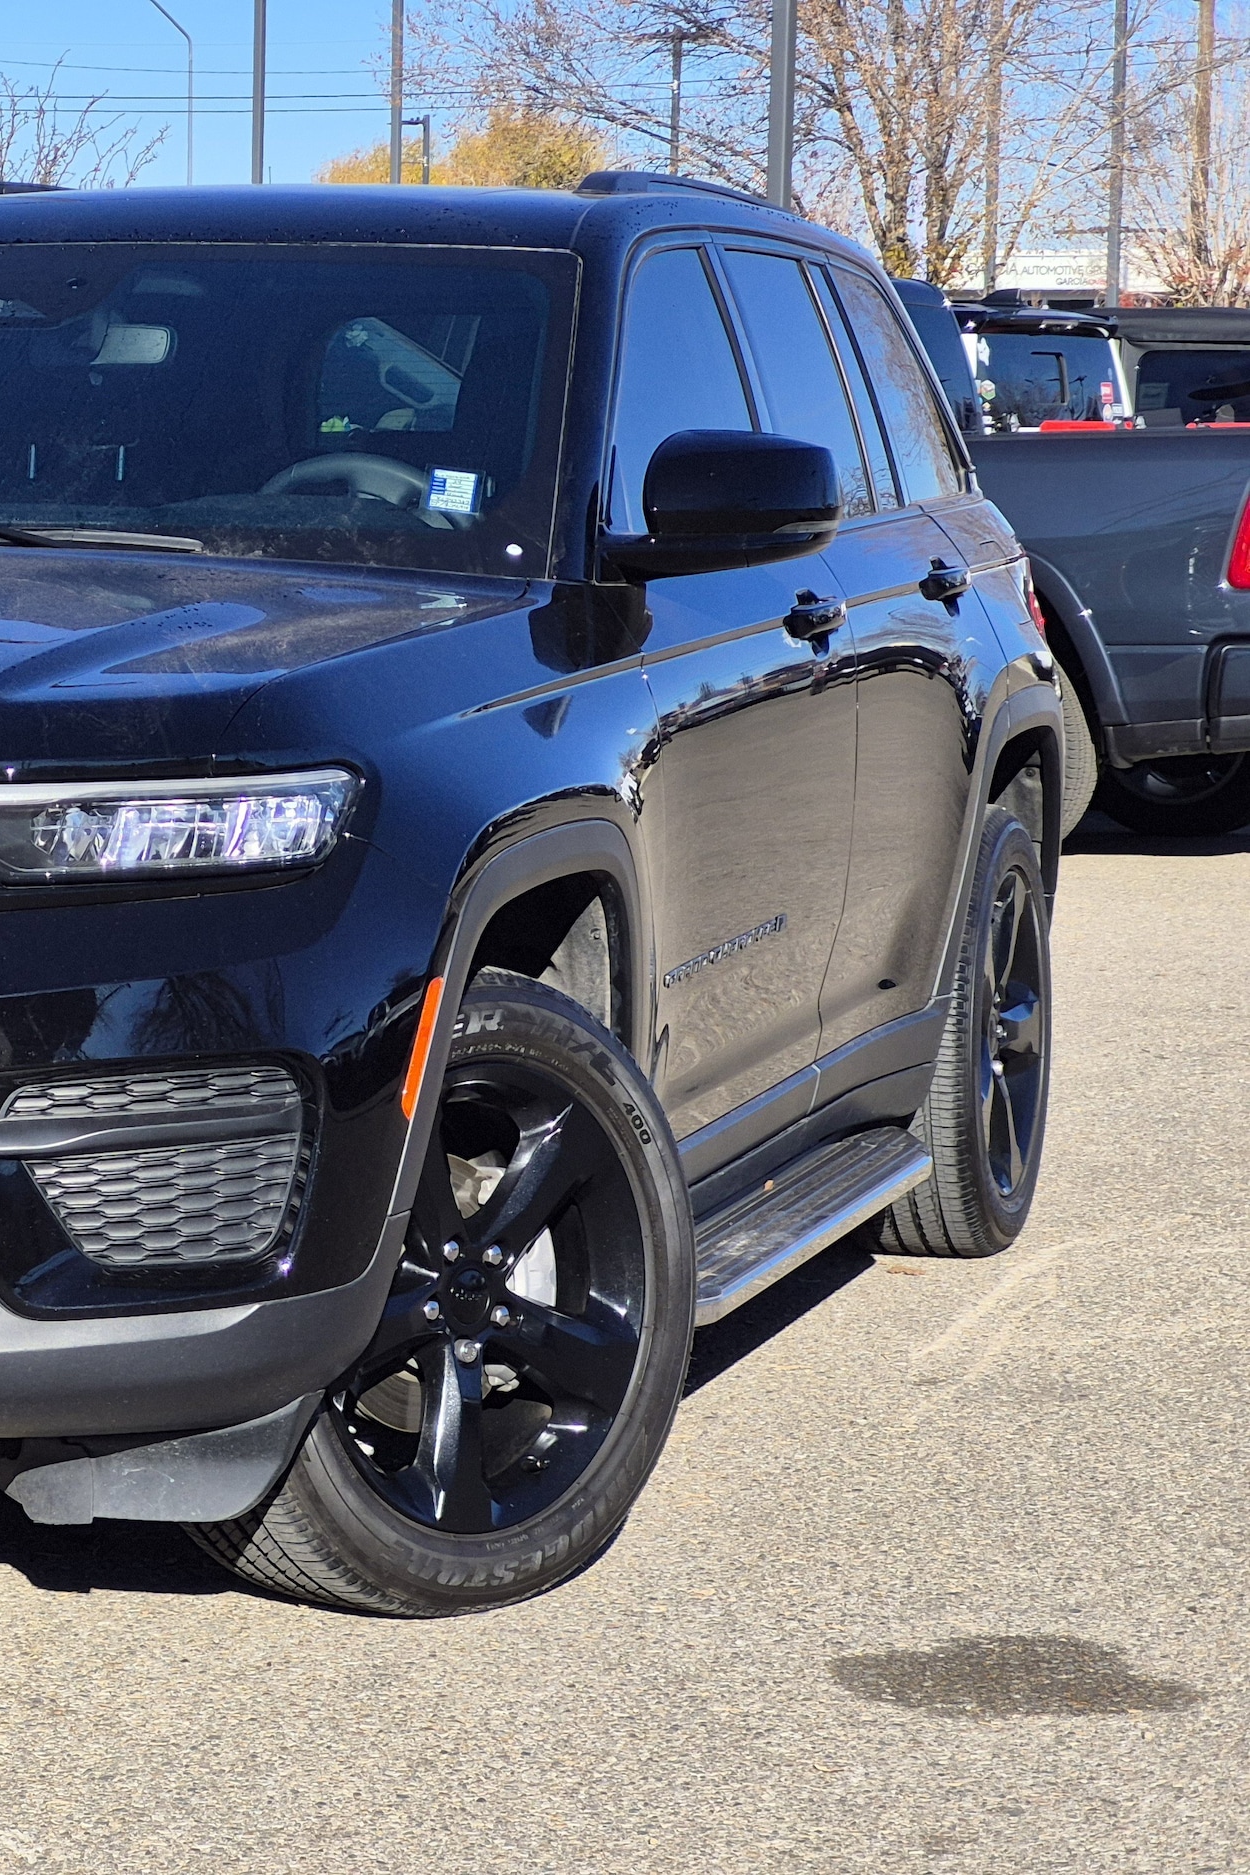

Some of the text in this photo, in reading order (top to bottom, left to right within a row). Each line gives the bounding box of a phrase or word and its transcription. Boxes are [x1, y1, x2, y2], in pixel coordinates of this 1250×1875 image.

[1021, 264, 1084, 276] AUTOMOTIVE
[1085, 264, 1108, 276] GRO
[451, 1008, 505, 1040] ER
[622, 1101, 652, 1146] 400
